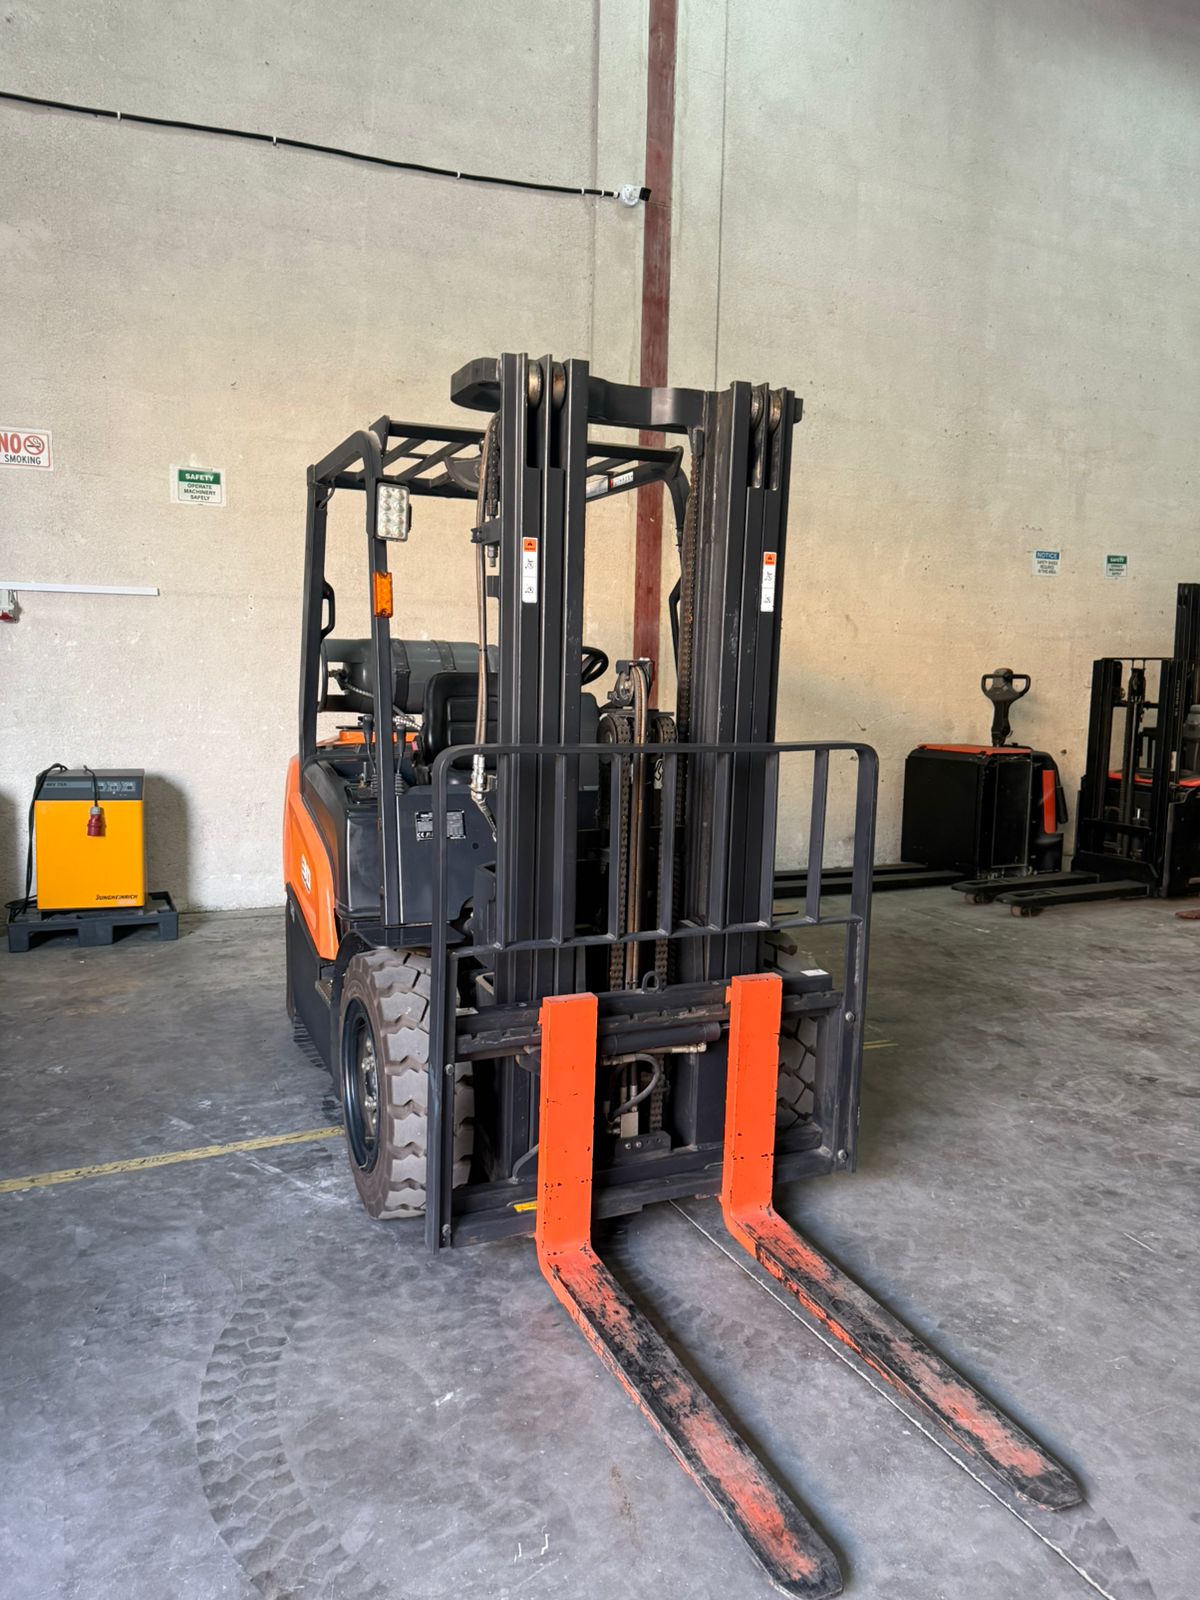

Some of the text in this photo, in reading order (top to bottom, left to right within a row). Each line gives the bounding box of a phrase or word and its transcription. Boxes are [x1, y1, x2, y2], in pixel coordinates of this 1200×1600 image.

[0, 432, 22, 454] NO
[4, 454, 42, 465] SMOKING
[184, 472, 214, 482] SAFETY
[184, 488, 216, 496] MACHINERY
